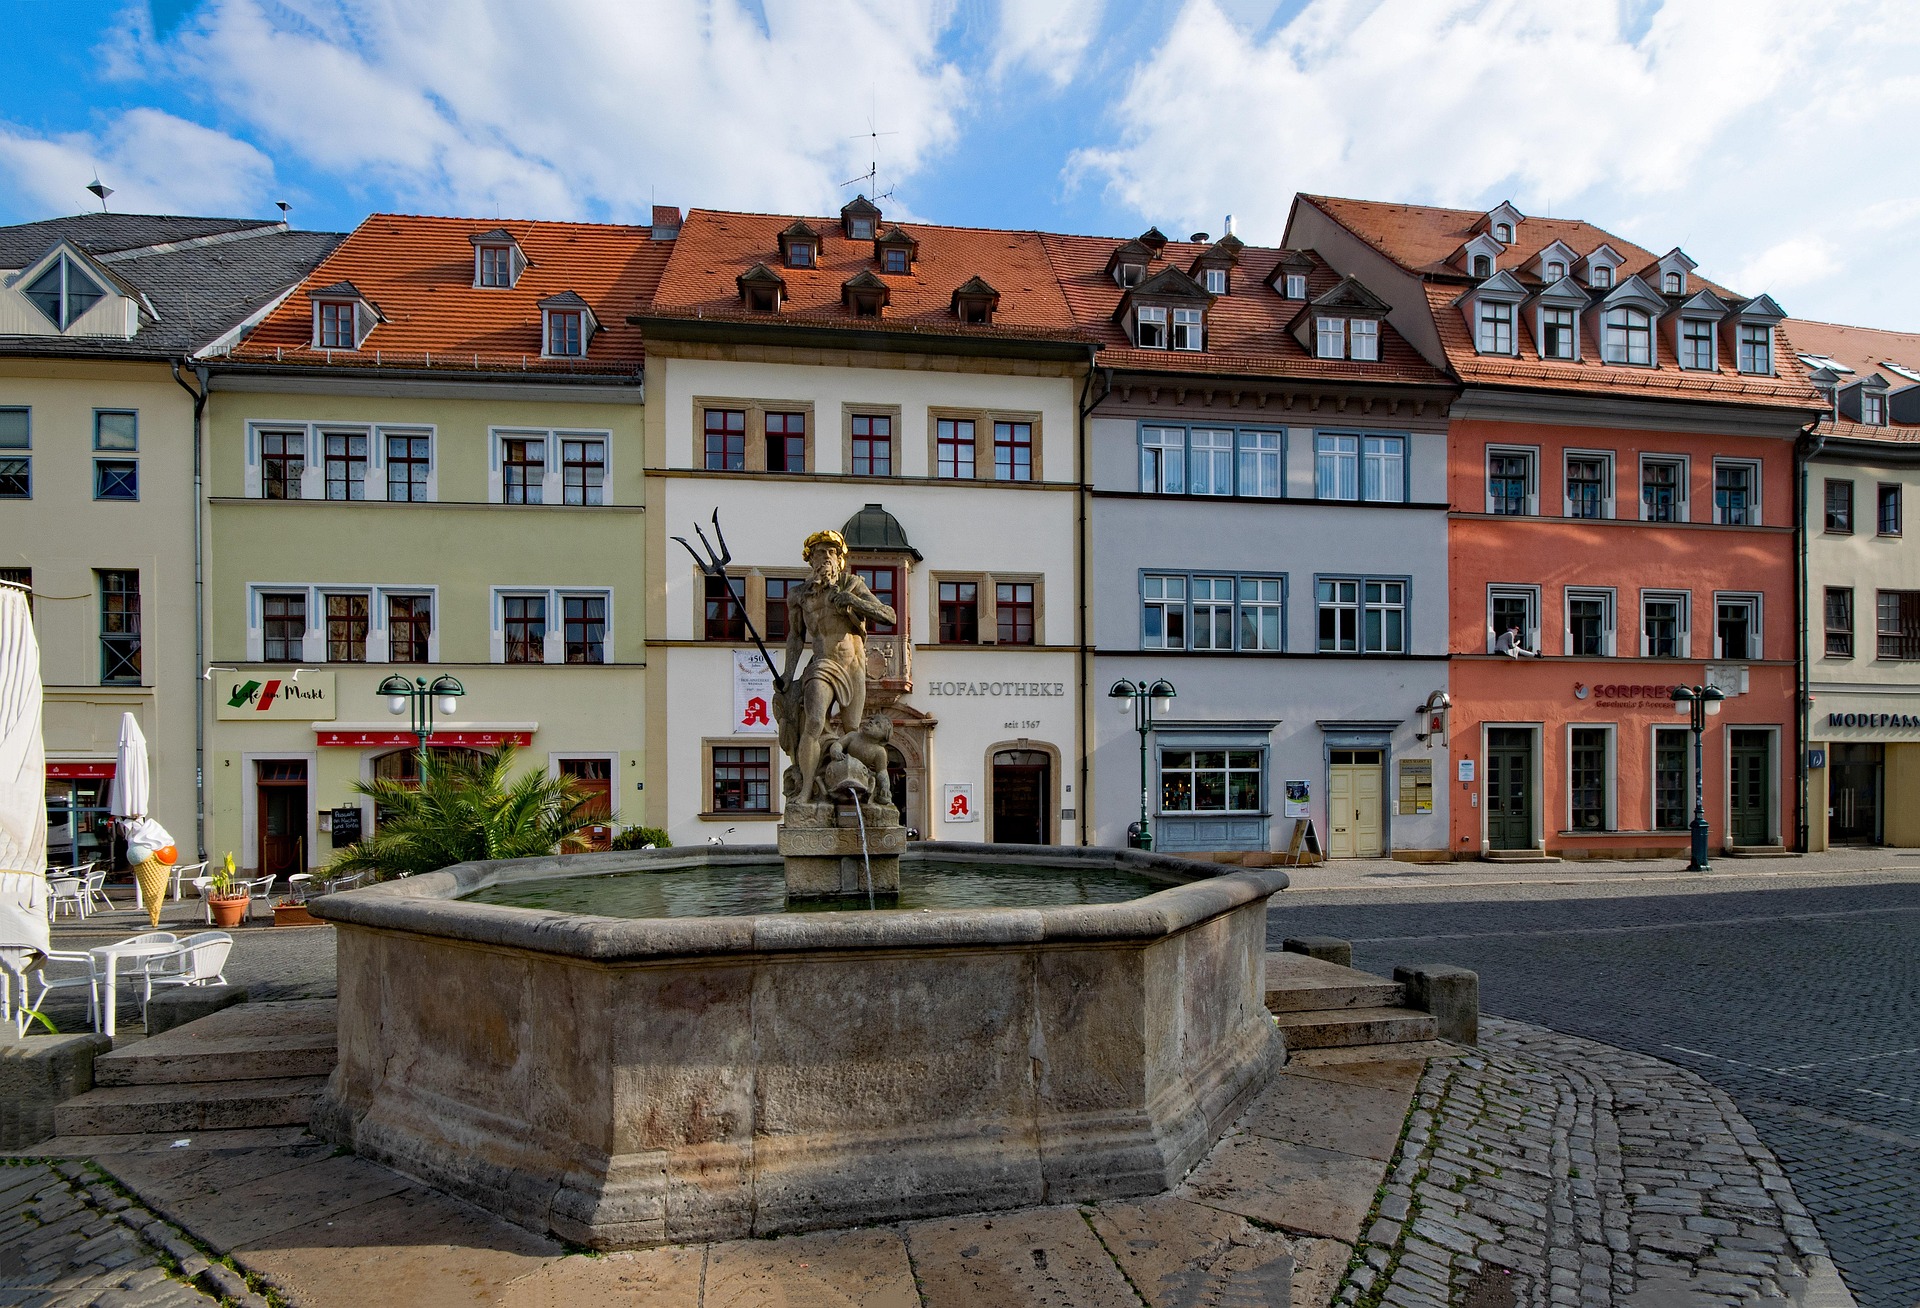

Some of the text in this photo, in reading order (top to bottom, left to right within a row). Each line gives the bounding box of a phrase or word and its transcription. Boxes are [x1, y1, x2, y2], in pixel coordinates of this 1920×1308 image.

[231, 683, 260, 704] Café
[284, 685, 325, 700] Markt
[929, 682, 1065, 697] HOFAPOTHEKE
[1593, 684, 1677, 699] SORPRES
[1645, 701, 1676, 709] Accesso
[1004, 720, 1019, 729] seit
[224, 759, 230, 767] 3
[631, 759, 636, 767] 3
